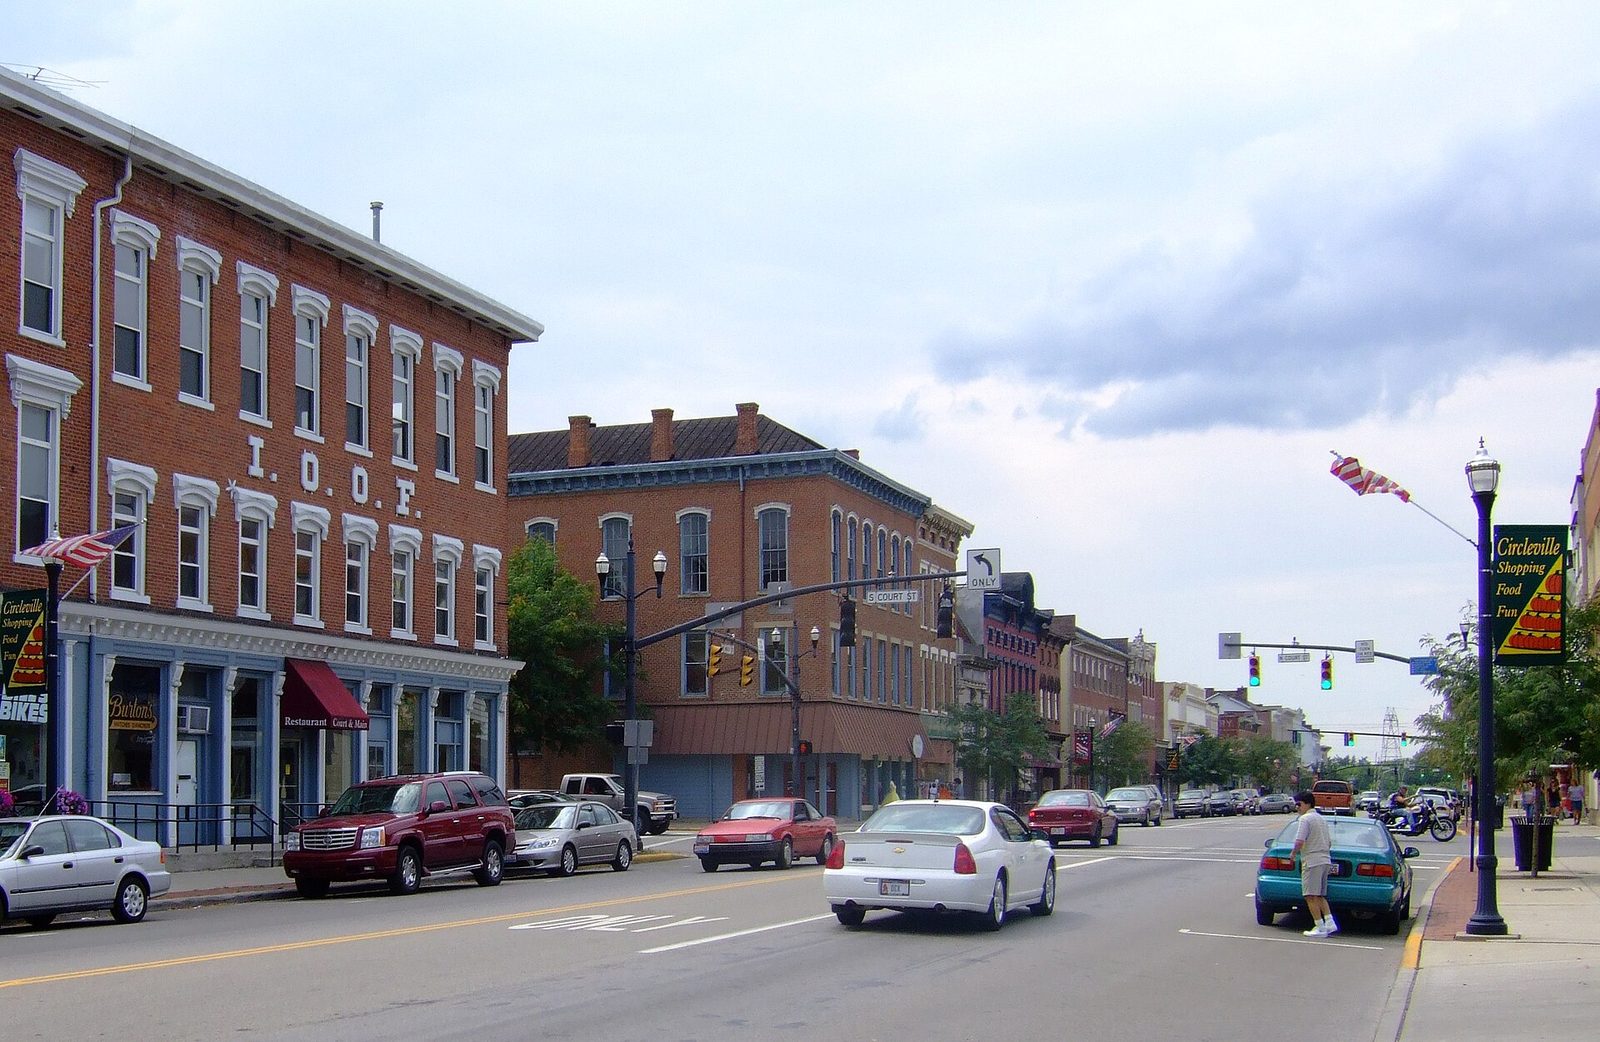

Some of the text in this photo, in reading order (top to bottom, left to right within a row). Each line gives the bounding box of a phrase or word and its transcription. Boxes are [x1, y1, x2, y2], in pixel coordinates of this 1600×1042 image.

[1497, 536, 1561, 556] Circleville
[1496, 561, 1546, 576] Shopping
[972, 578, 996, 587] ONLY
[1496, 582, 1522, 596] Food
[868, 592, 916, 602] S COURT ST
[3, 598, 43, 615] Circleville
[1496, 605, 1518, 618] Fun
[2, 617, 33, 630] Shopping
[2, 634, 18, 644] Food
[3, 651, 17, 661] Fun
[0, 701, 48, 723] BIKES
[110, 694, 153, 719] Burton's
[284, 716, 327, 726] Restaurant
[332, 717, 347, 728] Court
[354, 719, 368, 728] Main
